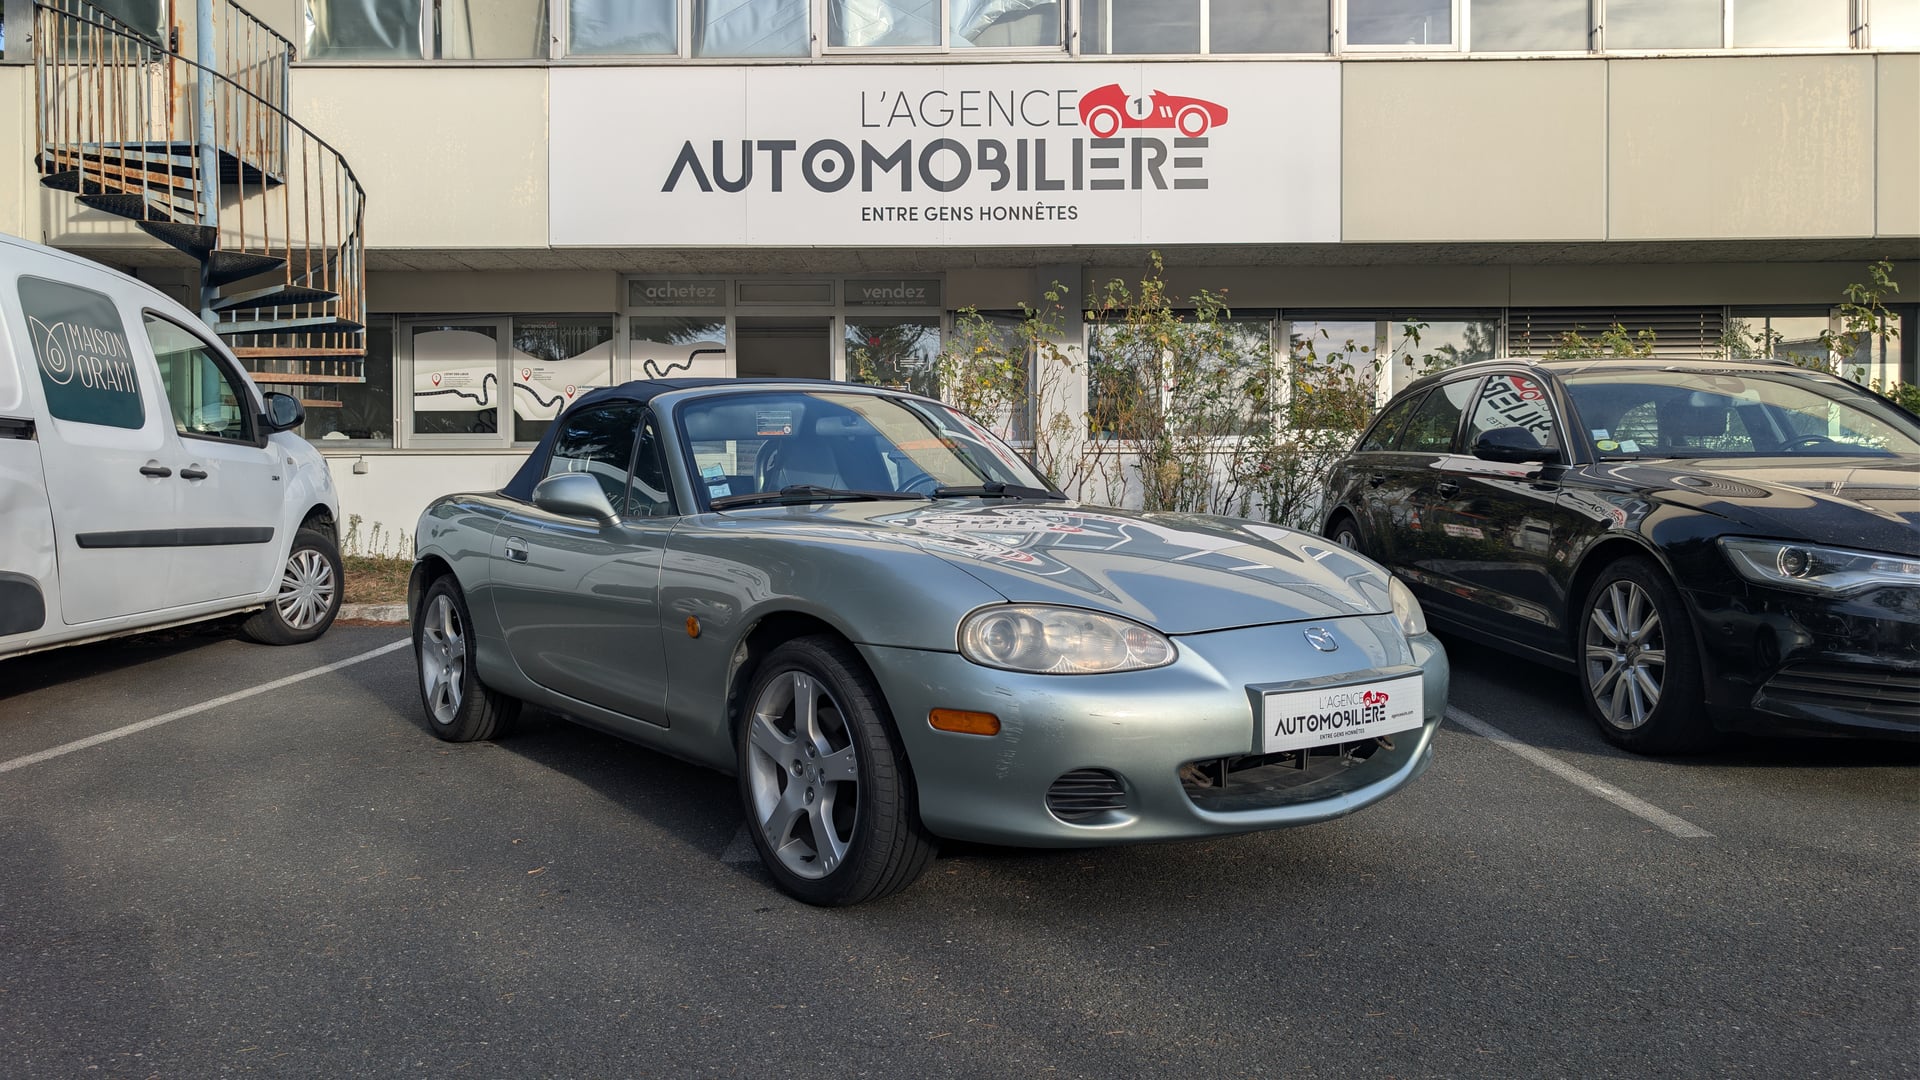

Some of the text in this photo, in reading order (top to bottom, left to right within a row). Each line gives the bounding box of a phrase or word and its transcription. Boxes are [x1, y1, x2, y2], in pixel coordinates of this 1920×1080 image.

[861, 89, 1079, 128] L'AGENCE
[1134, 98, 1142, 115] 1
[661, 137, 1209, 194] AUTOMOBILIERE
[861, 201, 1078, 222] ENTRE GENS HONNÊTES
[646, 281, 716, 298] achetez
[862, 281, 926, 298] vendez
[68, 323, 127, 358] MAISON
[78, 355, 135, 392] ORAMI
[1319, 692, 1364, 709] L'AGENCE
